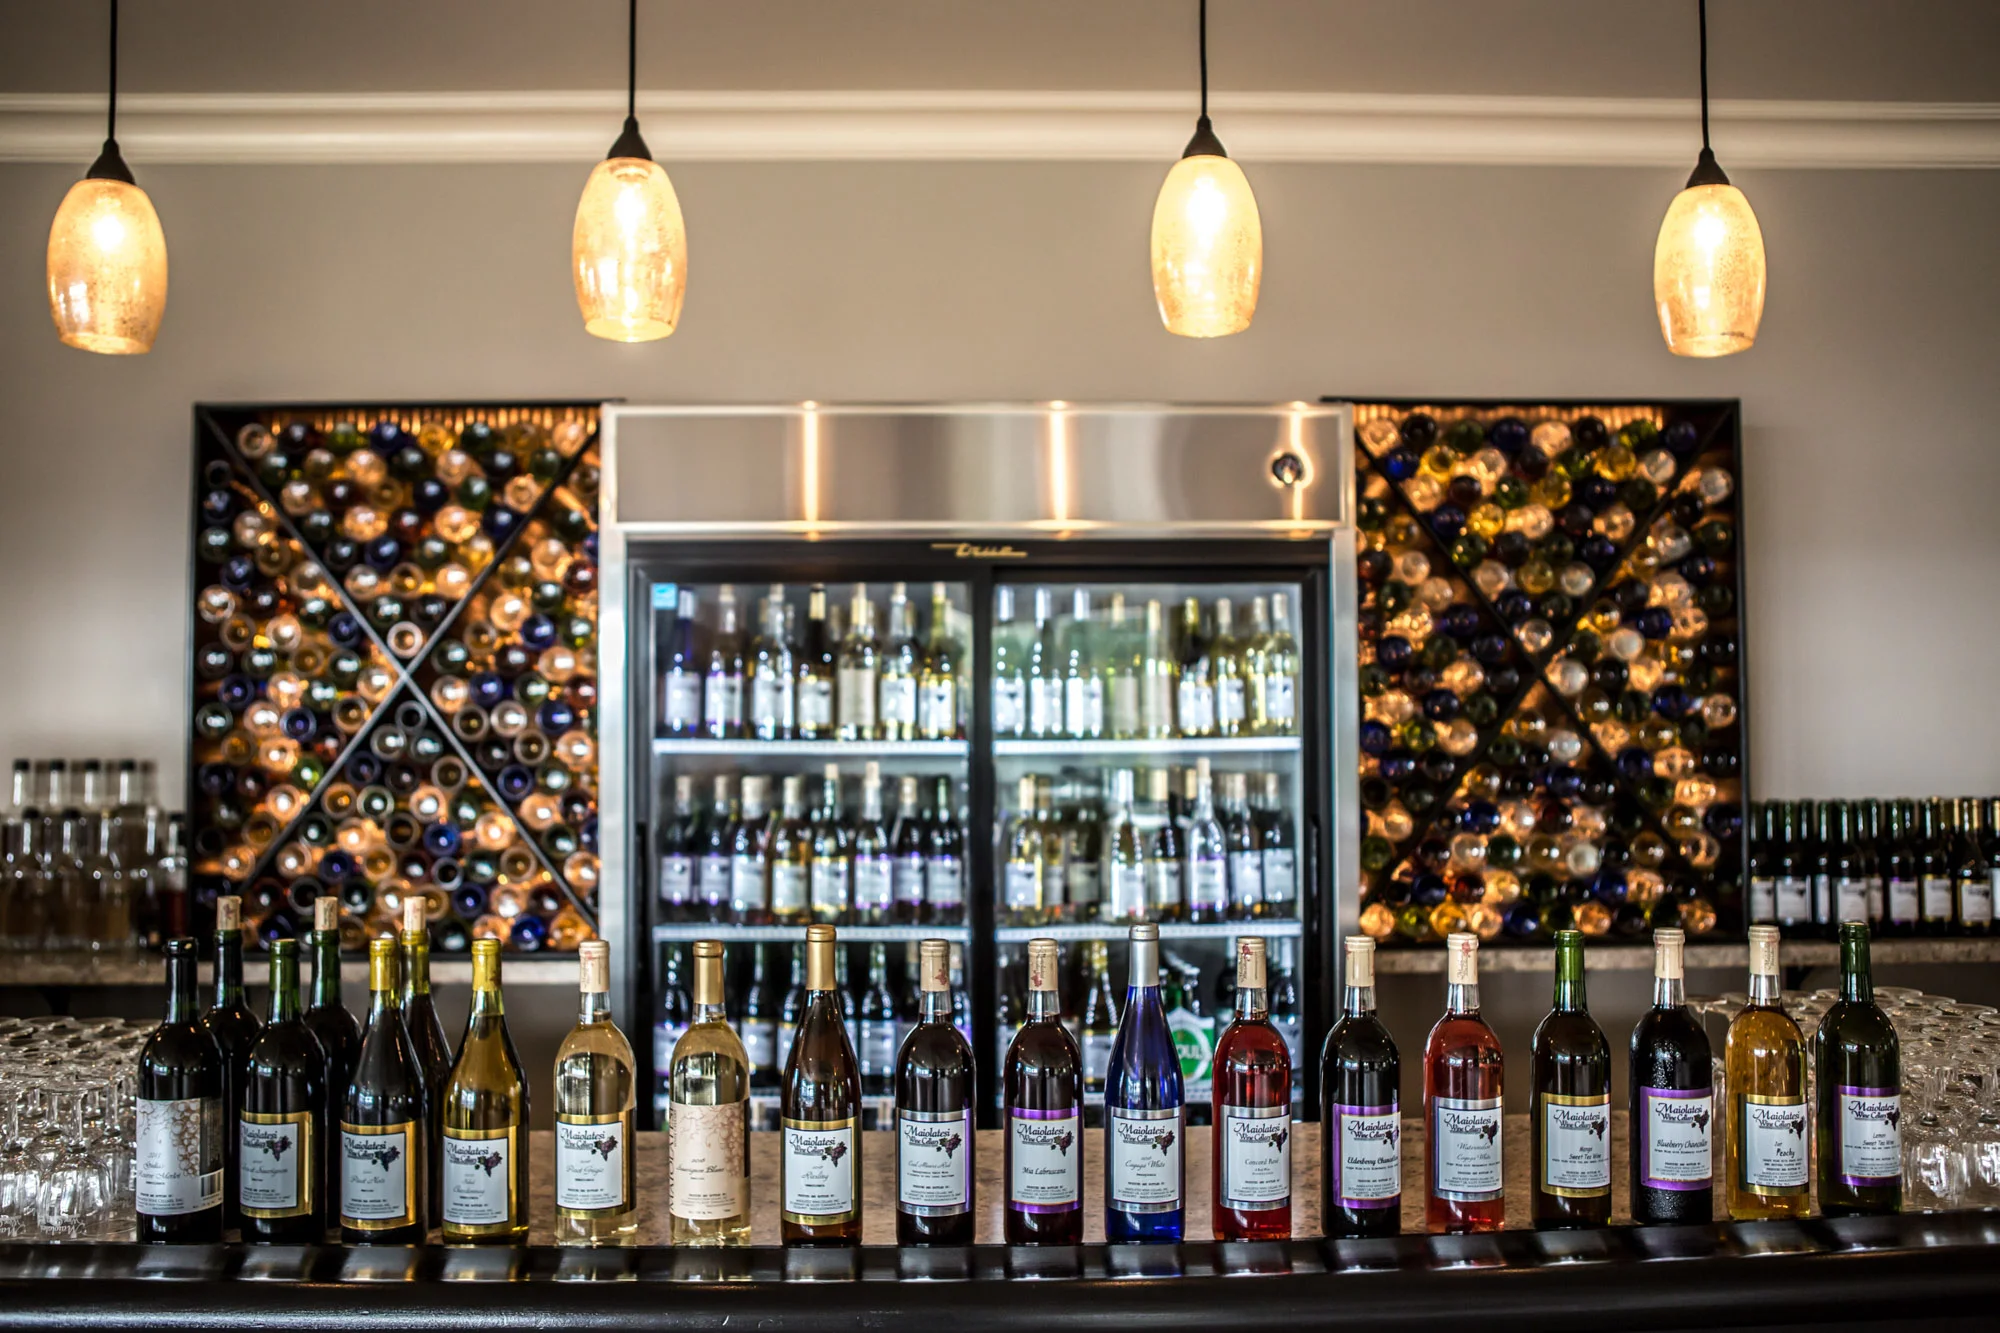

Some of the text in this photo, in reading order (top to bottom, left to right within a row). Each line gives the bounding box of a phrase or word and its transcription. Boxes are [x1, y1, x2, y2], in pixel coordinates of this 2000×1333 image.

[1656, 1103, 1702, 1113] Maiolatesi
[1848, 1101, 1895, 1111] Maiolatesi
[1444, 1113, 1491, 1124] Maiolatesi
[1553, 1110, 1600, 1120] Maiolatesi
[1753, 1109, 1800, 1120] Maiolatesi
[905, 1125, 950, 1137] Maiolatesi
[1017, 1123, 1064, 1135] Maiolatesi
[1118, 1123, 1165, 1134] Maiolatesi
[1234, 1122, 1280, 1133] Maiolatesi
[1348, 1121, 1393, 1131] Maiolatesi
[560, 1128, 605, 1140] Maiolatesi
[790, 1134, 835, 1146] Maiolatesi
[1657, 1140, 1683, 1150] Blueberry
[1776, 1148, 1795, 1158] Peachy
[1347, 1157, 1376, 1166] Elderberry
